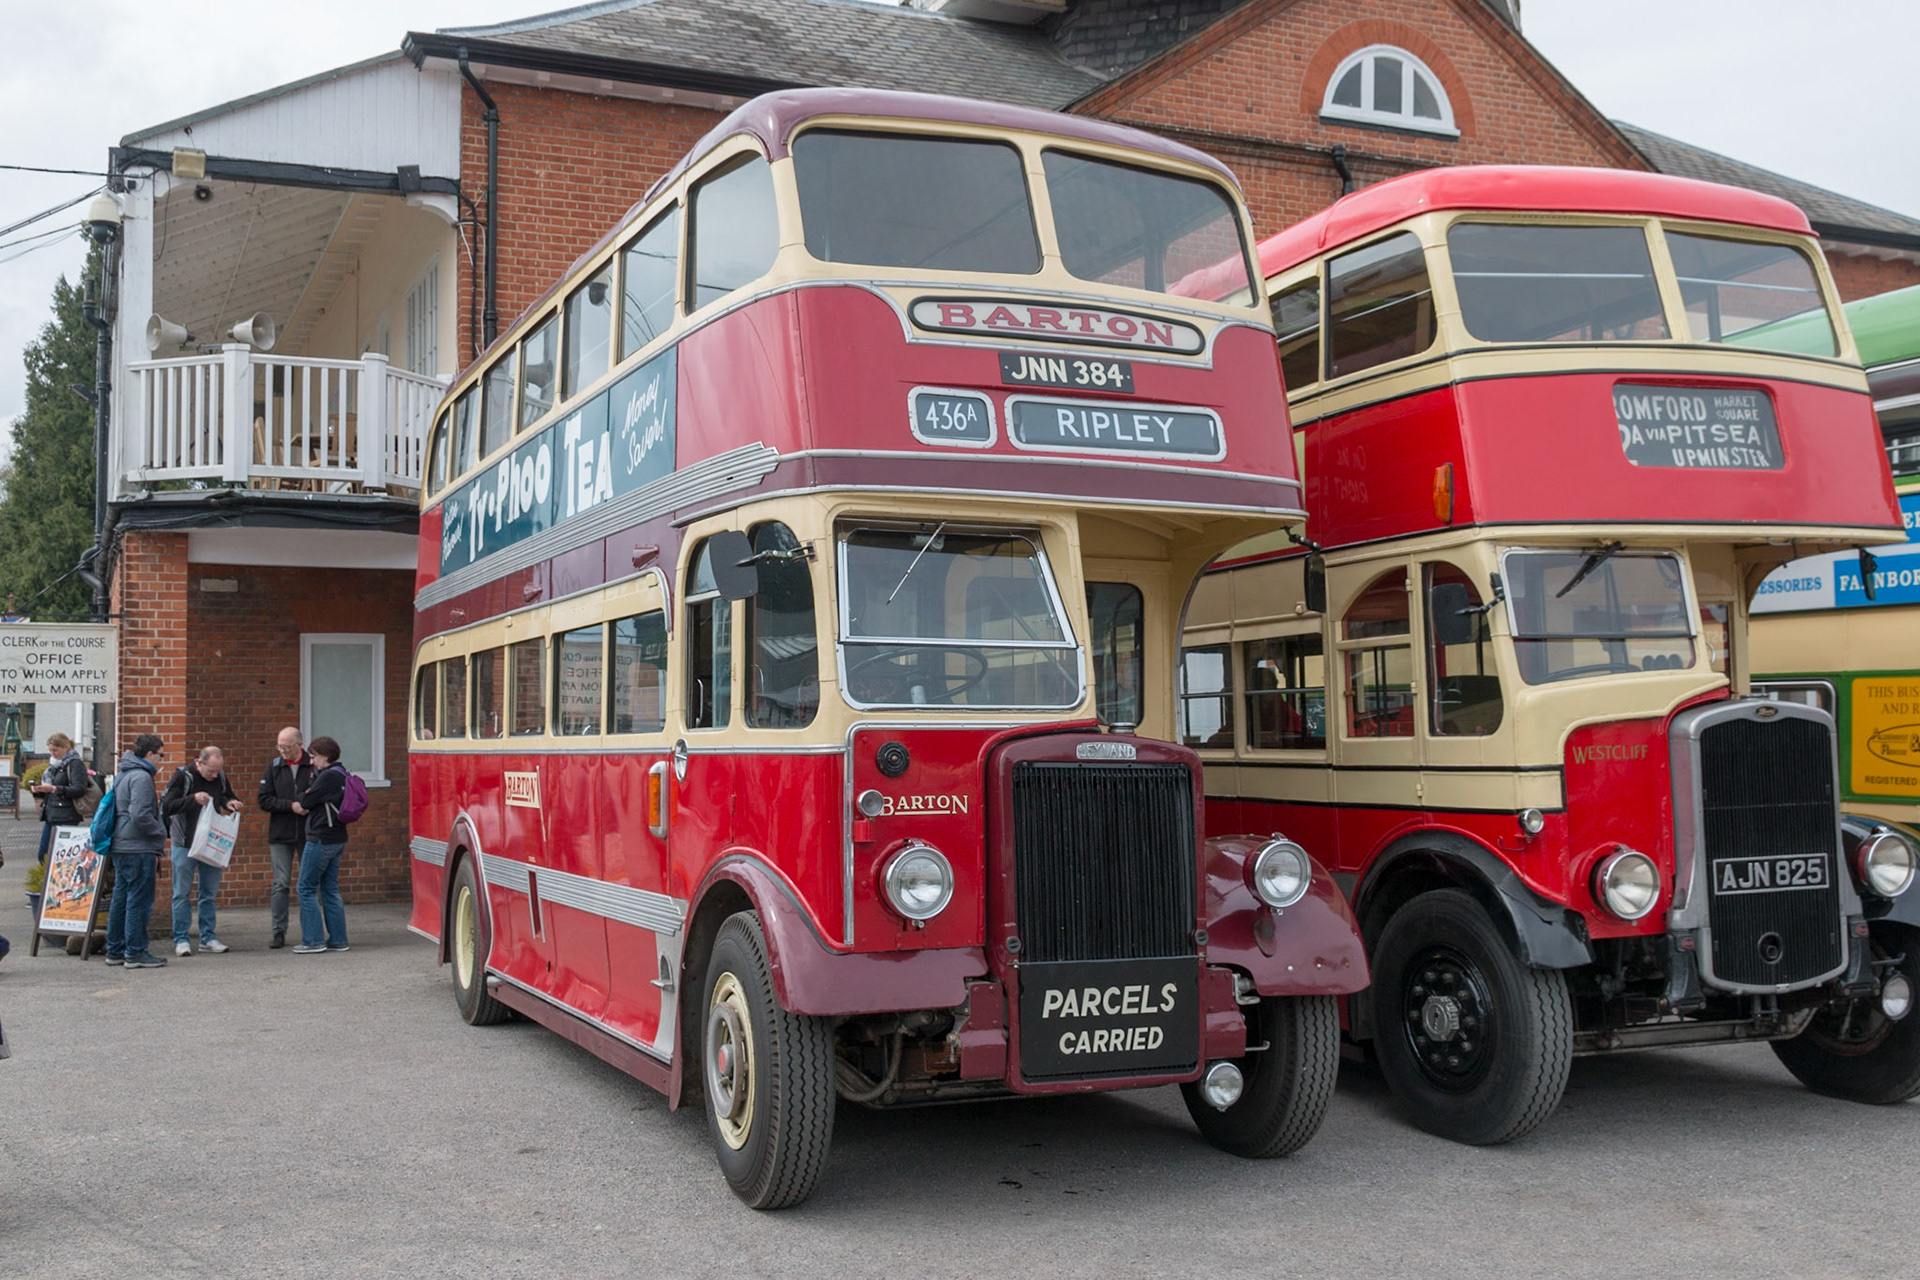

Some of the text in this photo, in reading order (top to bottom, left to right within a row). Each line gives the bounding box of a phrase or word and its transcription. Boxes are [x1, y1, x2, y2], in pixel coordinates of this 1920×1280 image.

[936, 303, 1174, 347] BARTON
[1012, 356, 1124, 388] JNN 384
[622, 373, 660, 439] Money
[1714, 395, 1758, 408] MARKET
[925, 401, 977, 431] 436A
[1716, 409, 1760, 421] SQUARE
[627, 398, 667, 475] Saver!
[1056, 409, 1174, 444] RIPLEY
[1645, 428, 1667, 441] VIA
[1667, 424, 1761, 446] PITSEA
[564, 411, 613, 518] TEA
[1672, 446, 1770, 468] UPMINSTER
[1756, 577, 1822, 595] ESSORIES
[1839, 568, 1920, 592] FANBO
[2, 636, 39, 647] CLERK
[52, 640, 65, 648] THE
[67, 637, 106, 648] COURSE
[26, 653, 83, 665] OFFICE
[0, 669, 108, 680] TO WHOM APPLY
[2, 684, 107, 694] IN ALL MATTERS
[1866, 685, 1919, 698] THIS BUS
[1881, 703, 1909, 715] AND
[1572, 744, 1649, 765] WESTCLIFF
[506, 776, 537, 803] BARTON
[1865, 776, 1918, 786] REGISTERED
[880, 795, 968, 816] BARTON
[55, 844, 81, 860] 1940
[1722, 858, 1823, 889] AJN 825
[1042, 983, 1178, 1018] PARCELS
[1059, 1026, 1164, 1055] CARRIED
